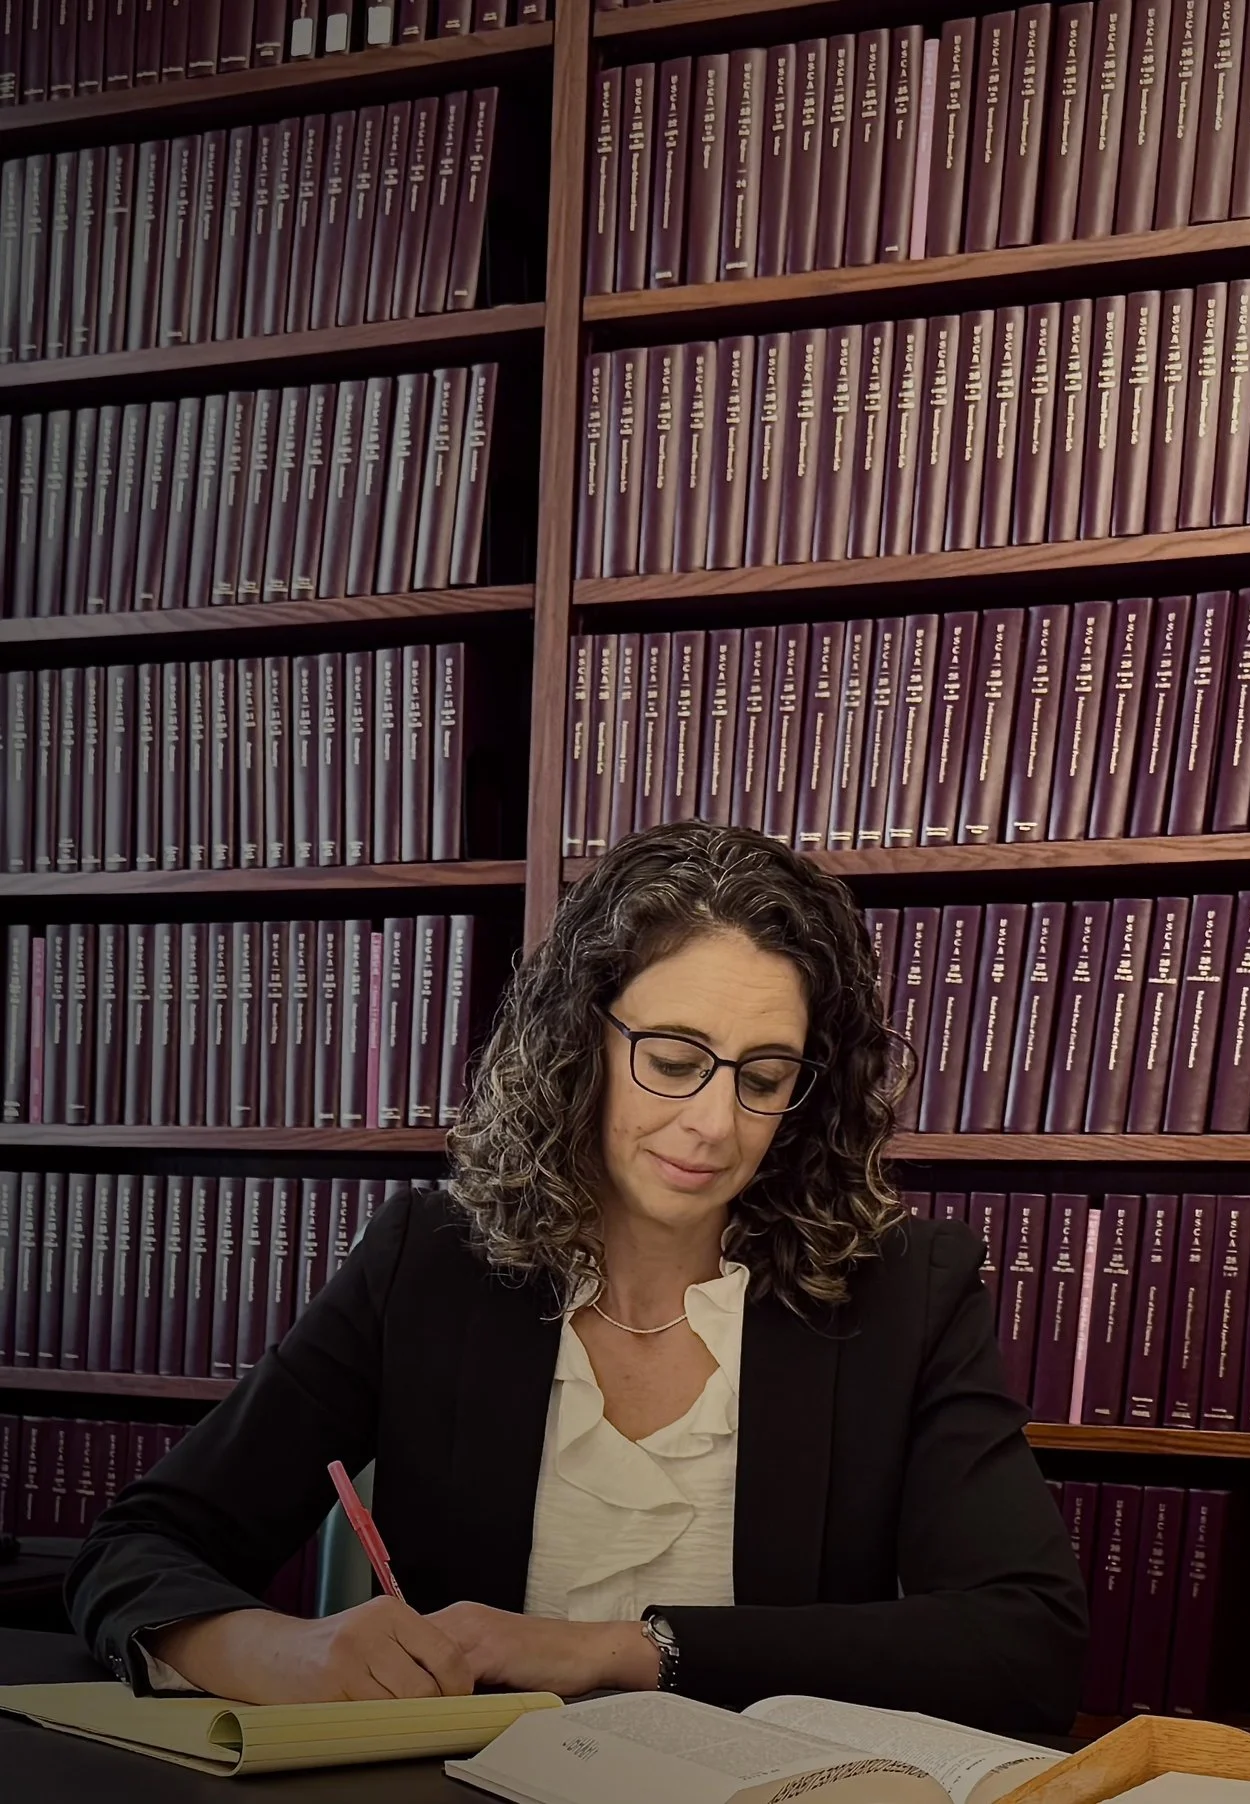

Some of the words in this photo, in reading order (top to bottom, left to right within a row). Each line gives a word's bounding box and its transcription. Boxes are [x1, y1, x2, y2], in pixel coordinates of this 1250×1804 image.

[1106, 12, 1118, 52] USCA
[1146, 8, 1156, 46] USCA
[1238, 295, 1248, 334] USCA
[1204, 910, 1216, 948] USCA
